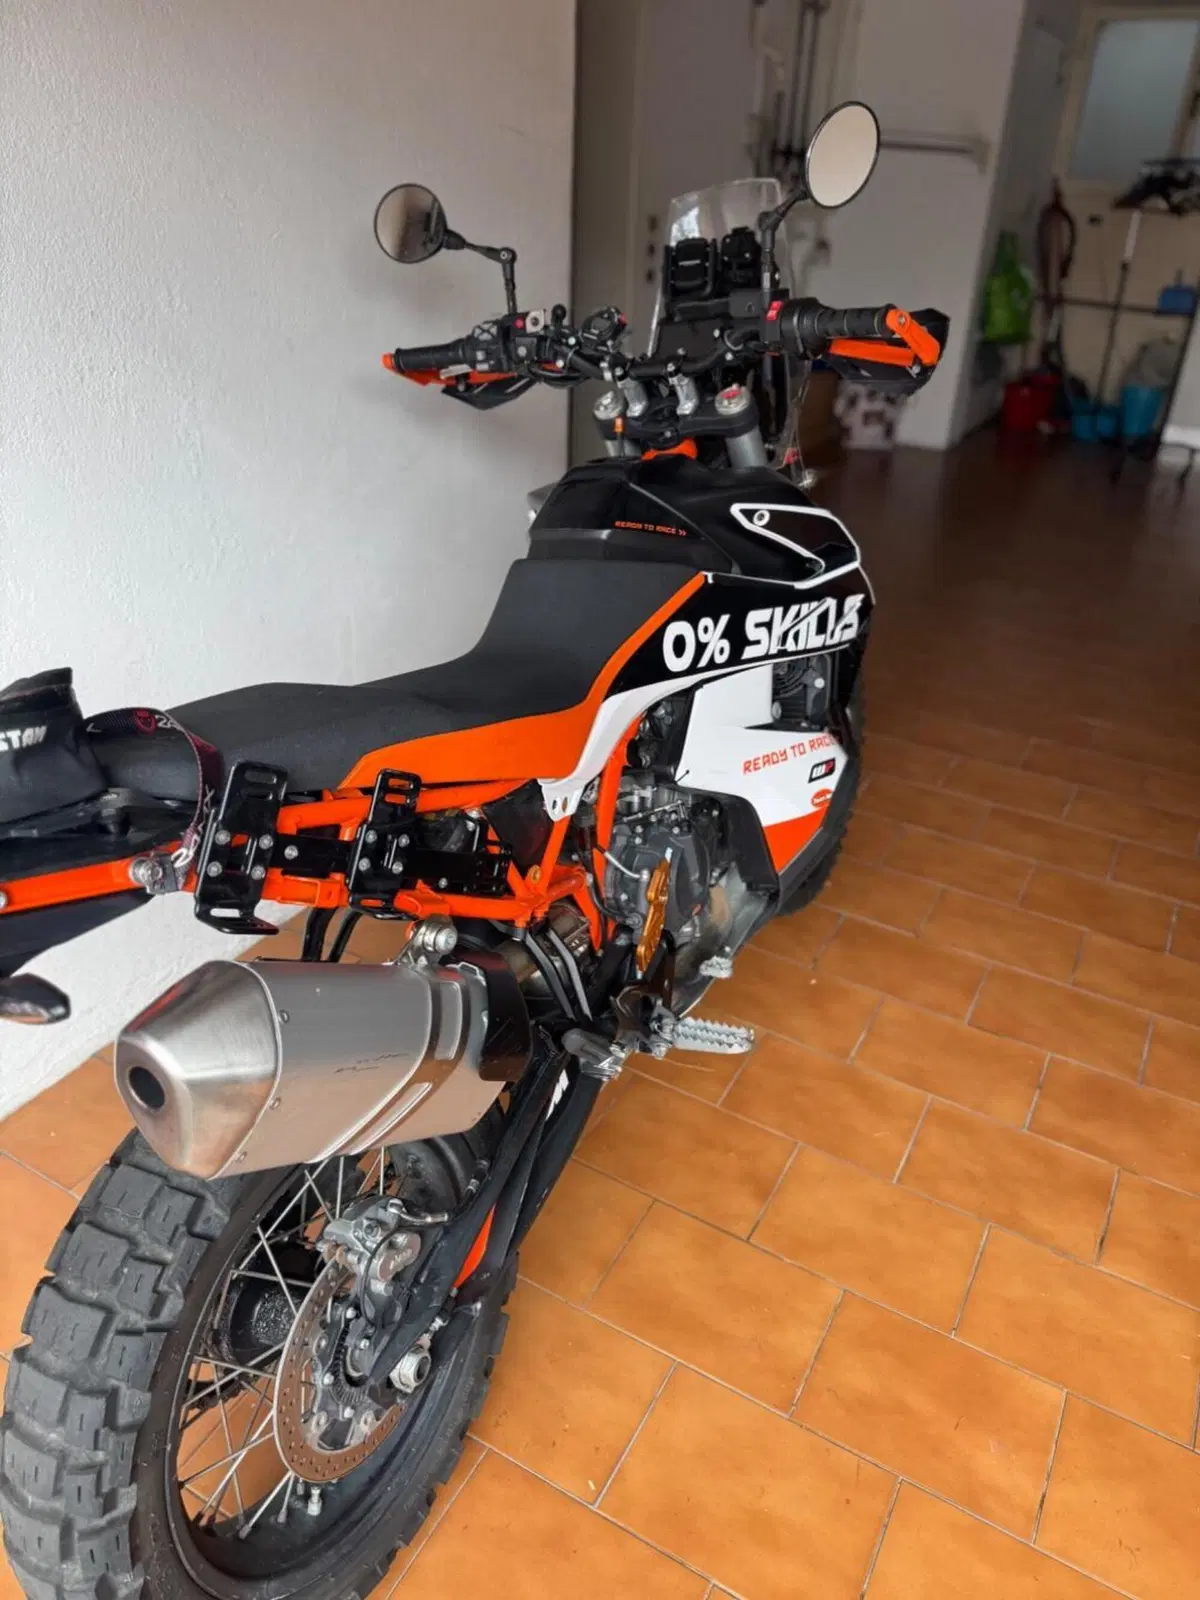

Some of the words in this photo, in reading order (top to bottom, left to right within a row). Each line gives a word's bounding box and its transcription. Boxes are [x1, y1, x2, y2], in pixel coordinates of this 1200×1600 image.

[643, 523, 655, 531] TO
[662, 614, 731, 673] 0%
[742, 747, 789, 775] READY
[790, 741, 806, 758] TO
